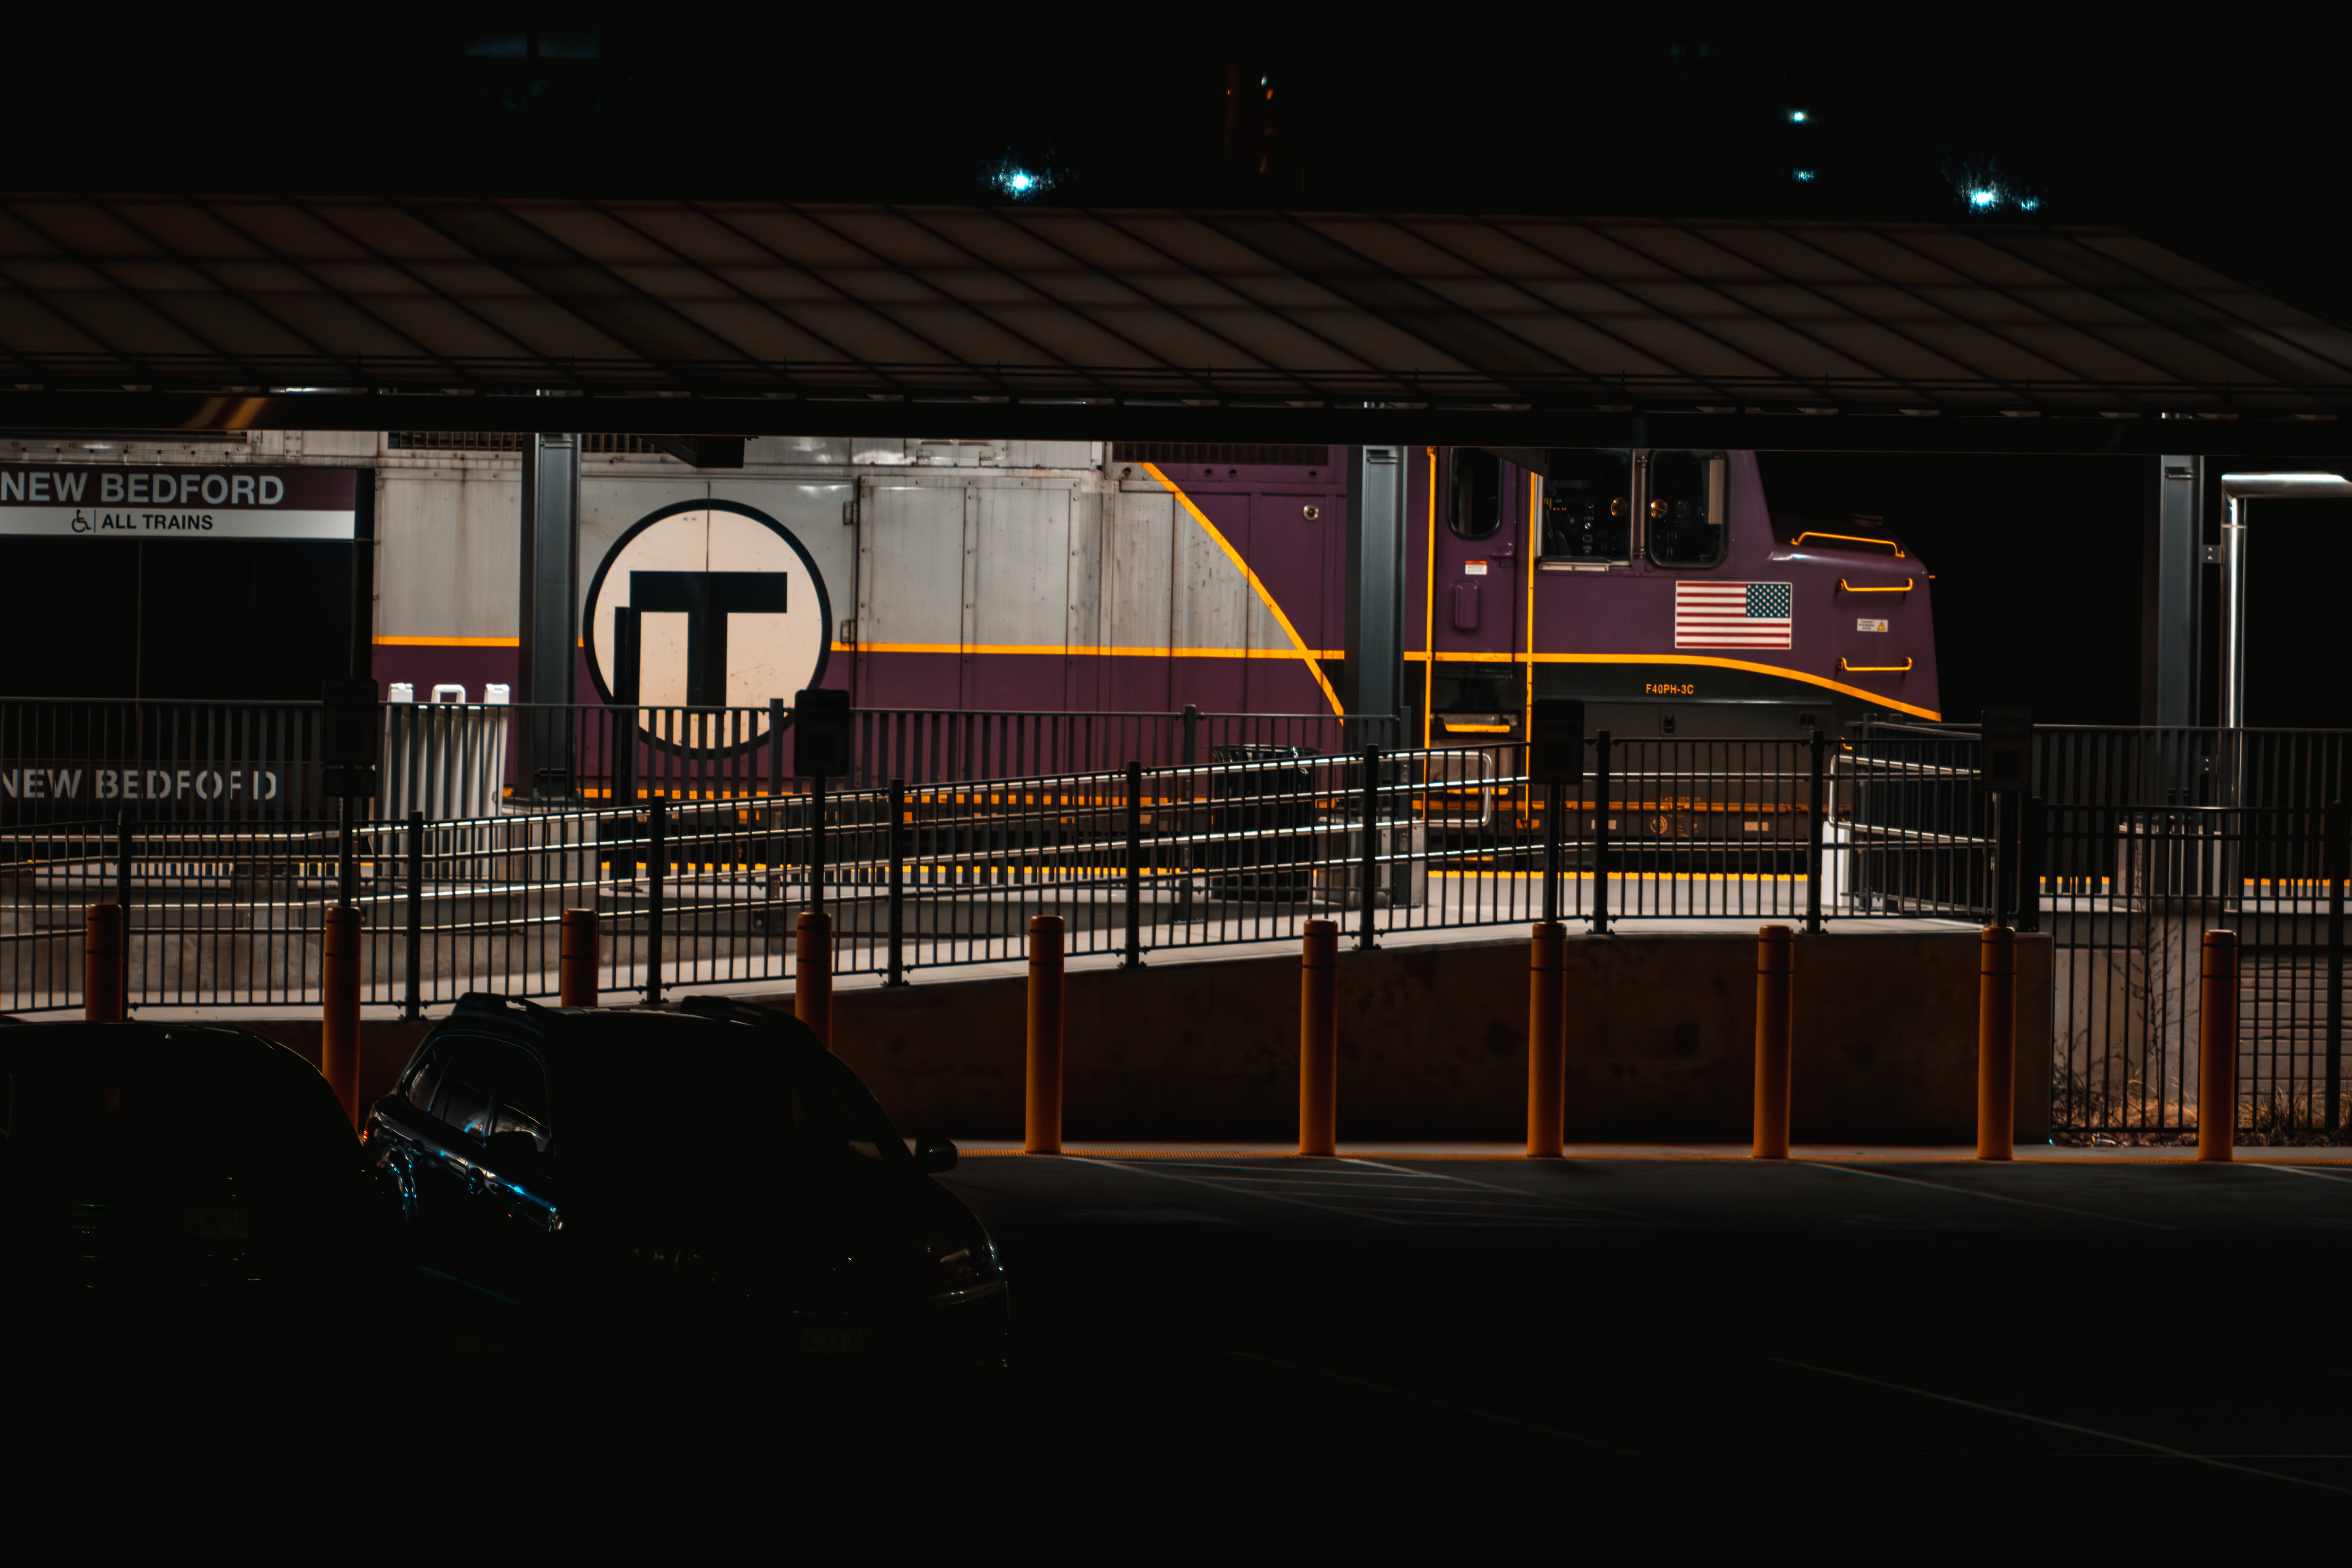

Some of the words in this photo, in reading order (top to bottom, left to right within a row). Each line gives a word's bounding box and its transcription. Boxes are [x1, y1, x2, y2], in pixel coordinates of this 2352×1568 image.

[1, 472, 87, 502] NEW
[101, 473, 284, 505] BEDFORD
[101, 514, 136, 529] ALL
[142, 514, 213, 530] TRAINS
[630, 571, 787, 713] T
[1646, 684, 1694, 695] F40PH-3C
[1, 769, 82, 799] NEW
